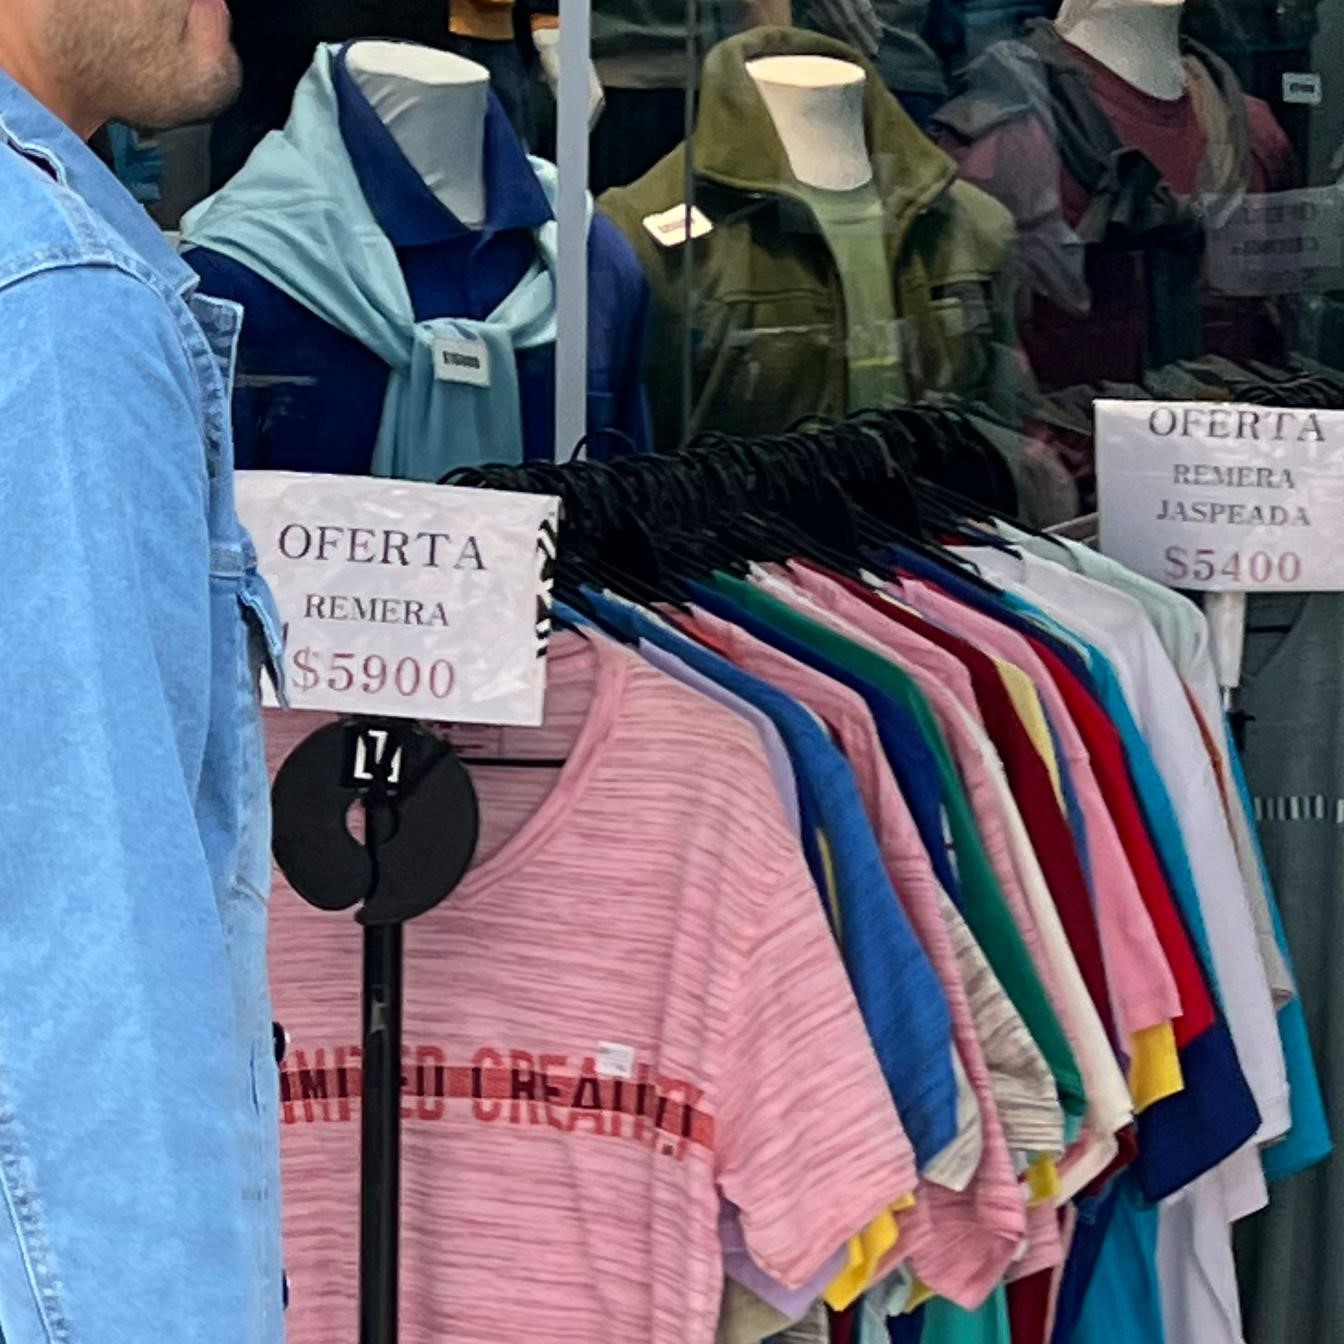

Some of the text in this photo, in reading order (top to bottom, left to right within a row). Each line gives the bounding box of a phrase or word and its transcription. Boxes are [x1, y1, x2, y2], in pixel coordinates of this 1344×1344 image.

[1148, 405, 1326, 442] OFERTA
[1173, 463, 1296, 489] REMERA
[1155, 498, 1311, 526] JASPEADA
[278, 523, 486, 571] OFERTA
[1163, 545, 1303, 583] $5400
[304, 593, 450, 627] REMERA
[290, 643, 457, 700] $5900
